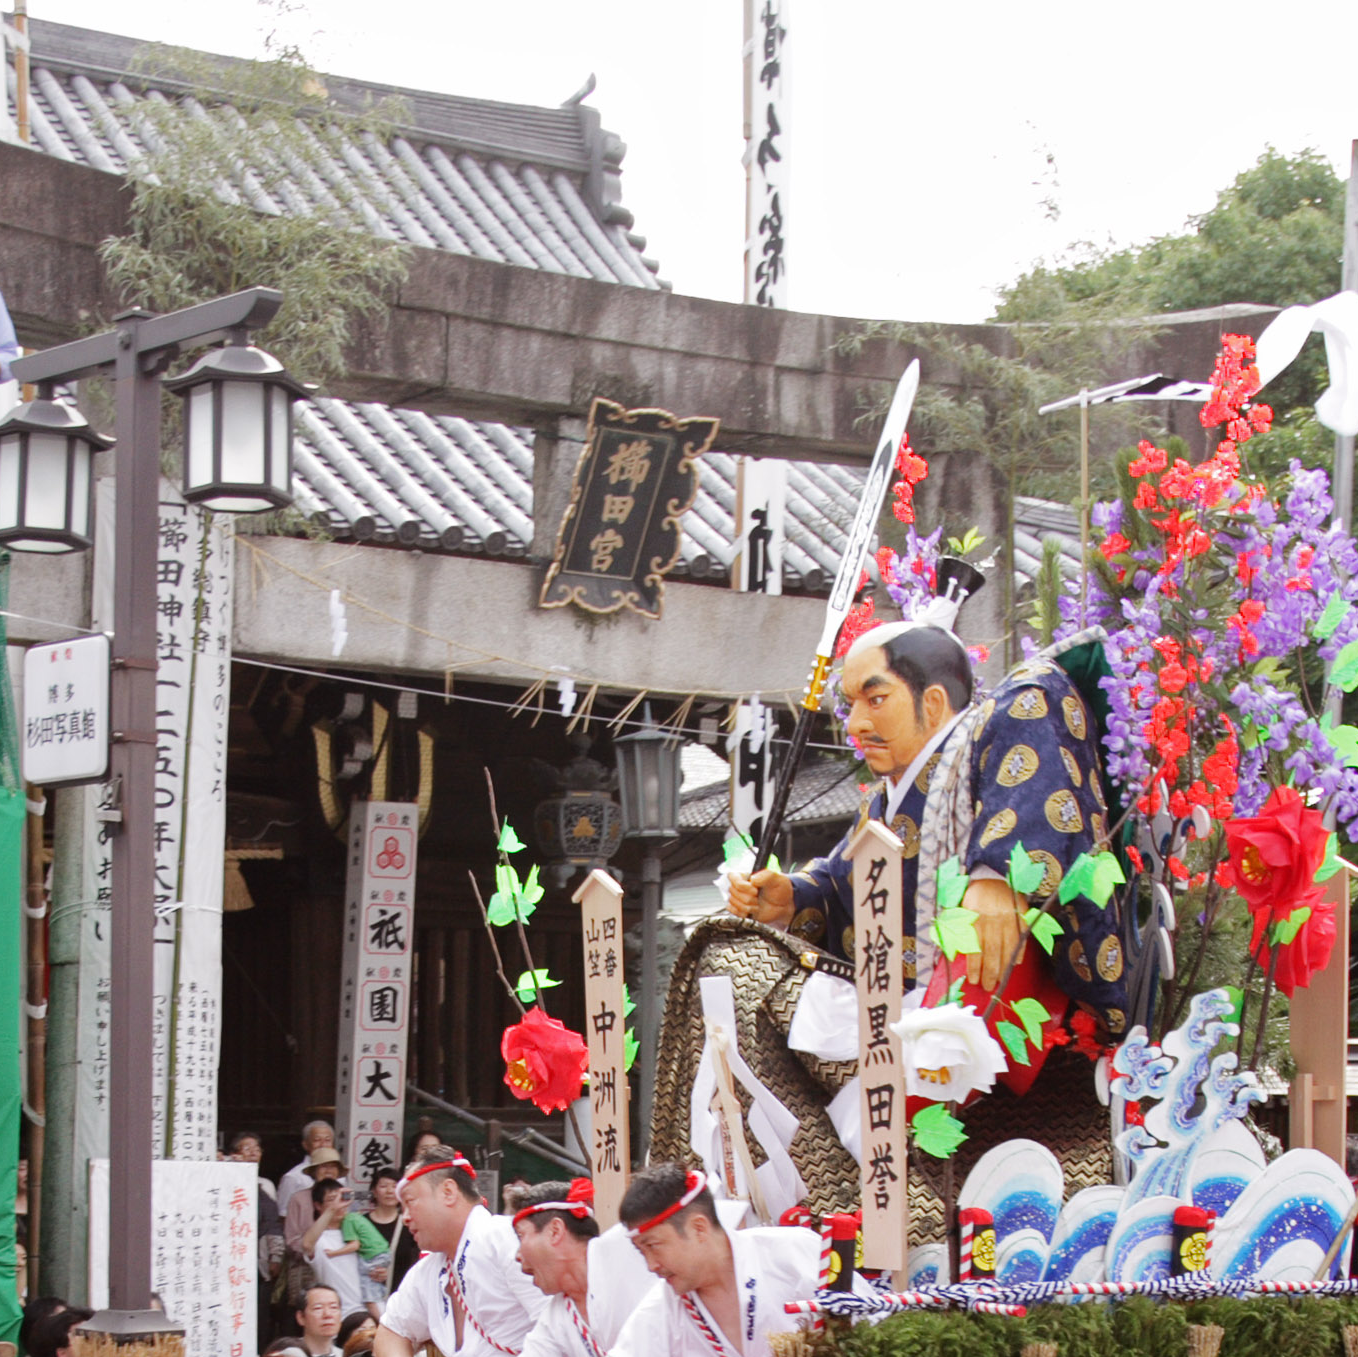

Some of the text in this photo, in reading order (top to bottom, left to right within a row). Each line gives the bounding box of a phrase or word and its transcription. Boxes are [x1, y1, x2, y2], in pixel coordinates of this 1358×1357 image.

[589, 438, 653, 573] 櫛田宮
[47, 683, 76, 704] 博多
[26, 708, 96, 749] 杉田写真館
[585, 917, 602, 979] 山笠
[601, 916, 618, 978] 四番
[859, 856, 899, 1210] 名槍黒田誉
[592, 1000, 621, 1174] 中洲流
